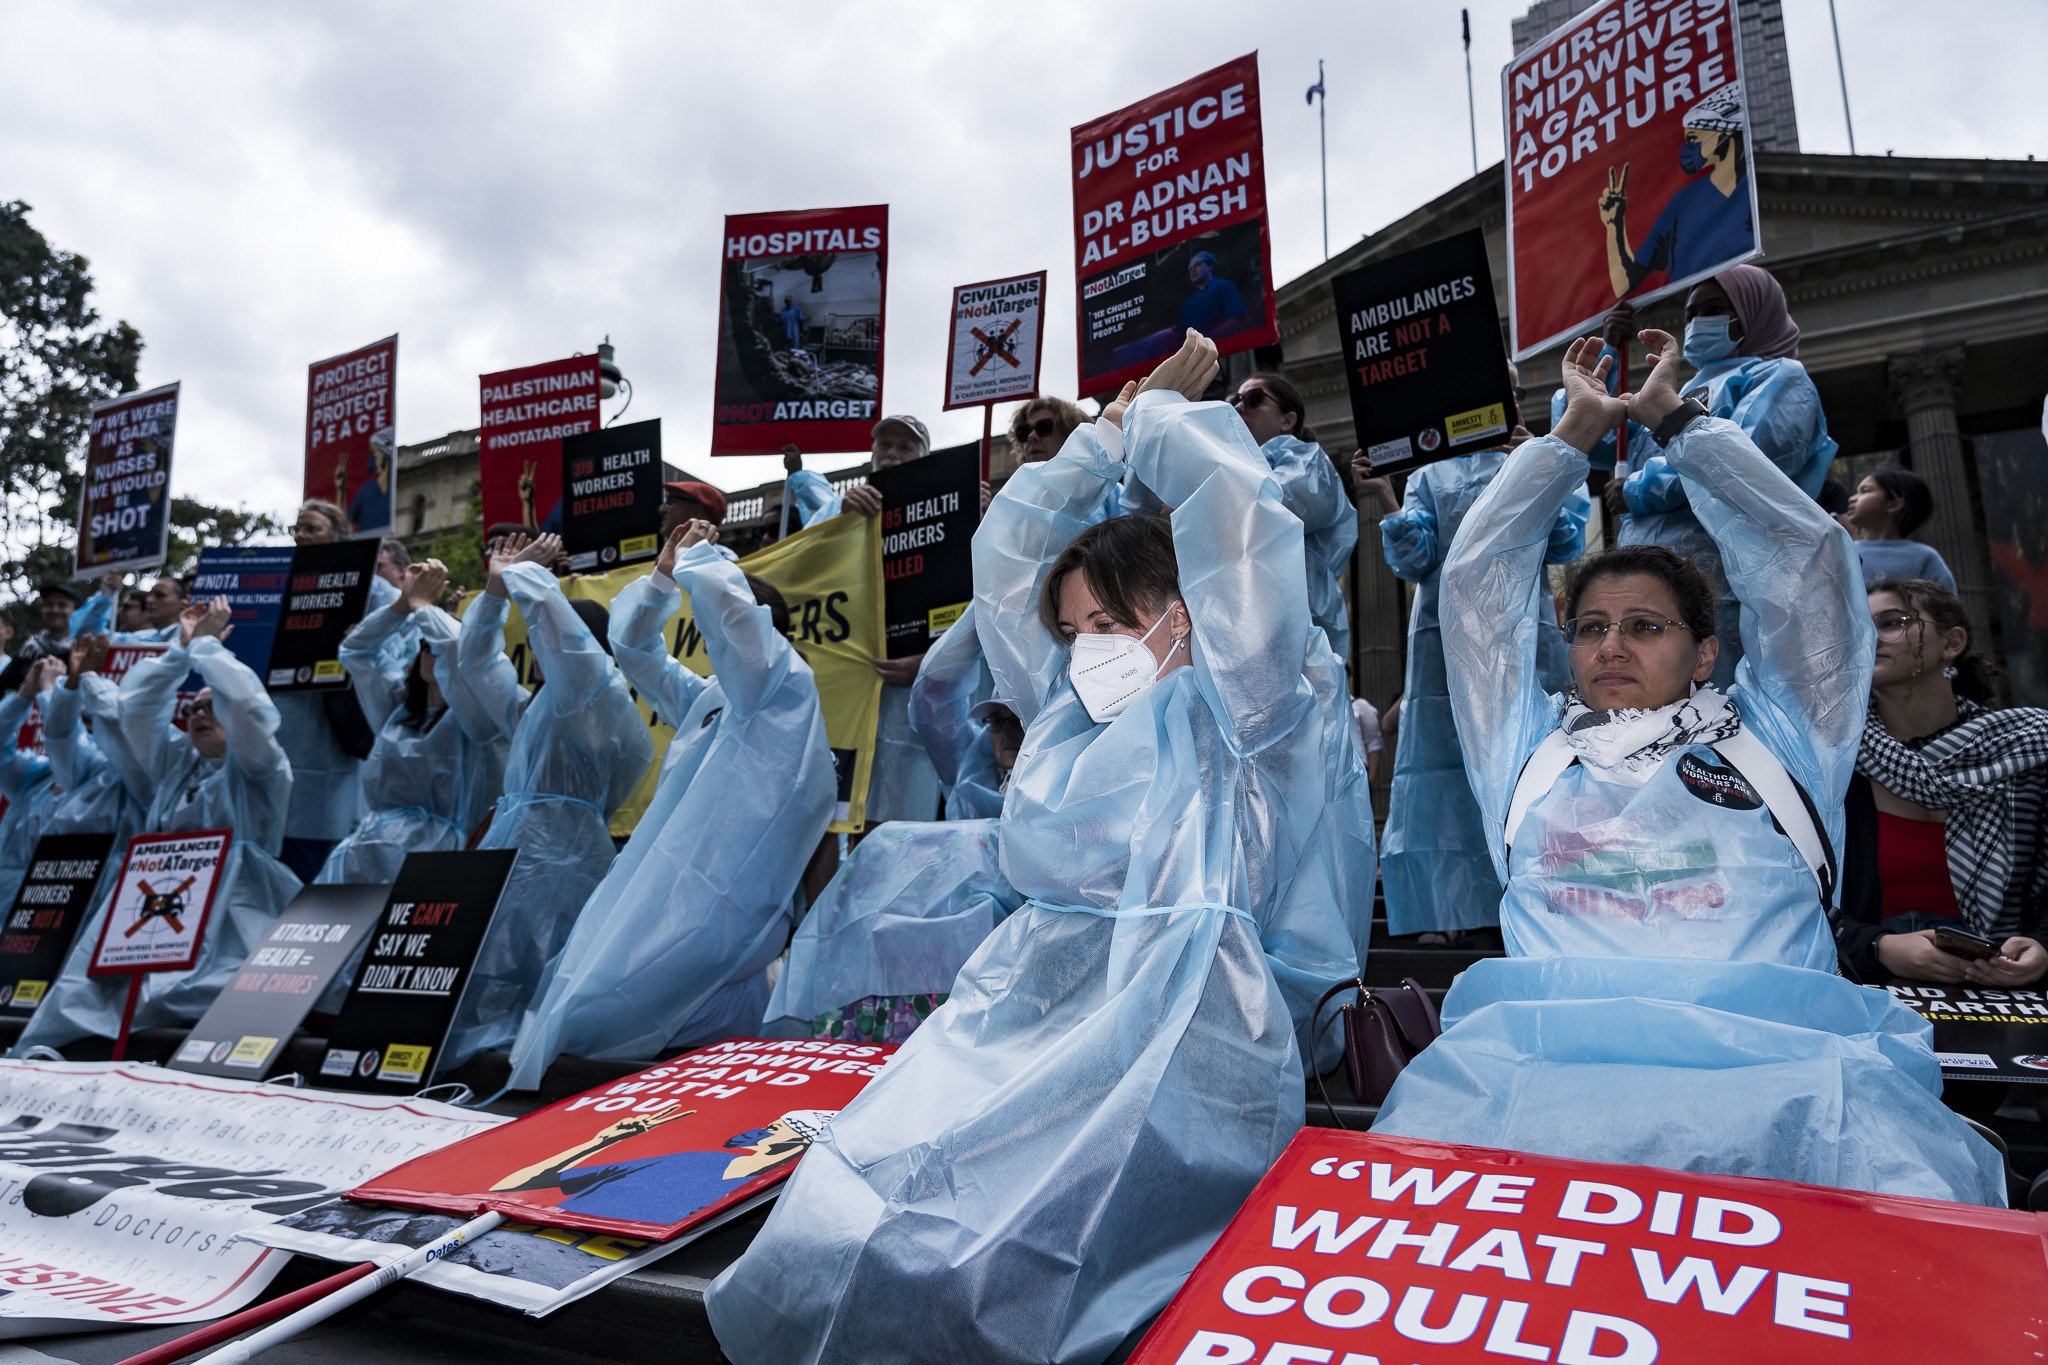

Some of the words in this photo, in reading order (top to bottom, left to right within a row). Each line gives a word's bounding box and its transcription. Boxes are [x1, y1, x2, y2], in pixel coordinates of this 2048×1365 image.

[1515, 0, 1673, 101] NURSE
[1515, 0, 1725, 132] MIDWIVES
[1513, 15, 1725, 166] AGAINST
[1079, 83, 1246, 179] JUSTICE
[1517, 53, 1725, 193] TORTURE
[1135, 147, 1179, 178] FOR
[1083, 200, 1124, 237] DR
[1131, 152, 1250, 218] ADNAN
[1082, 185, 1247, 267] AL-BURSH
[727, 227, 881, 258] HOSPITALS
[960, 280, 1039, 304] CIVILIANS
[1084, 264, 1146, 297] #NotATarget
[957, 296, 1040, 320] #NotATarget
[1106, 300, 1132, 315] CHOSE
[1133, 295, 1145, 305] TO
[1351, 276, 1476, 334] AMBULANCES
[1092, 320, 1103, 330] BE
[1104, 312, 1127, 325] WITH
[1127, 307, 1142, 318] HIS
[1356, 331, 1391, 361] ARE
[1395, 318, 1432, 347] NOT
[1439, 313, 1452, 335] A
[314, 351, 389, 393] PROTECT
[1358, 348, 1428, 386] TARGET
[313, 373, 388, 408] HEALTHCARE
[482, 370, 595, 404] PALESTINIAN
[91, 419, 105, 435] IF
[106, 410, 130, 430] WE
[130, 400, 175, 421] WERE
[312, 388, 388, 427] PROTECT
[482, 393, 597, 427] HEALTHCARE
[718, 400, 876, 423] #NOTATARGET
[1452, 413, 1482, 428] AMNESTY
[102, 431, 117, 447] IN
[119, 421, 159, 441] GAZA
[312, 409, 386, 448] PEACE
[488, 421, 591, 449] #NOTATARGET
[115, 442, 134, 457] AS
[94, 453, 157, 483] NURSES
[573, 461, 594, 477] 319
[603, 449, 650, 471] HEALTH
[88, 484, 109, 500] WE
[111, 470, 166, 494] WOULD
[572, 472, 635, 496] WORKERS
[114, 493, 130, 508] BE
[573, 491, 634, 515] DETAINED
[906, 491, 959, 524] HEALTH
[90, 505, 151, 538] SHOT
[317, 571, 360, 590] HEALTH
[885, 554, 924, 581] ILLED
[194, 573, 289, 589] #NOTATARGET
[290, 592, 344, 611] WORKERS
[285, 613, 324, 630] KILLED
[673, 591, 850, 658] WERS
[1682, 763, 1731, 787] WORKERS
[1734, 784, 1753, 797] ARE
[1686, 758, 1747, 789] HEALTHCARE
[1682, 773, 1701, 787] NOT
[1715, 785, 1752, 801] TARGE
[135, 840, 222, 856] AMBULANCES
[31, 860, 99, 880] HEALTHCARE
[128, 854, 219, 873] #NotATarget
[22, 885, 73, 904] WORKERS
[10, 909, 34, 929] ARE
[33, 910, 56, 929] NOT
[388, 903, 412, 925] WE
[411, 903, 458, 926] CAN'T
[1, 935, 41, 954] TARGET
[268, 924, 328, 942] ATTACKS
[323, 924, 351, 943] ON
[374, 934, 405, 957] SAY
[403, 934, 431, 958] WE
[251, 947, 304, 966] HEALTH
[233, 974, 271, 993] WAR
[264, 975, 318, 994] CRIMES
[360, 965, 411, 989] DIDN'T
[408, 967, 459, 991] KNOW
[1862, 984, 1946, 998] ND
[1963, 989, 2048, 1001] ISR
[707, 1040, 883, 1058] NURSES
[639, 1067, 811, 1087] STAND
[674, 1053, 884, 1077] MIDWIVES
[605, 1081, 748, 1099] WITH
[564, 1097, 682, 1113] YOU
[1556, 1179, 1784, 1248] DID
[425, 1239, 460, 1263] Oates
[1270, 1205, 1607, 1287] WHAT
[1630, 1247, 1854, 1341] WE
[1221, 1264, 1661, 1365] COULD
